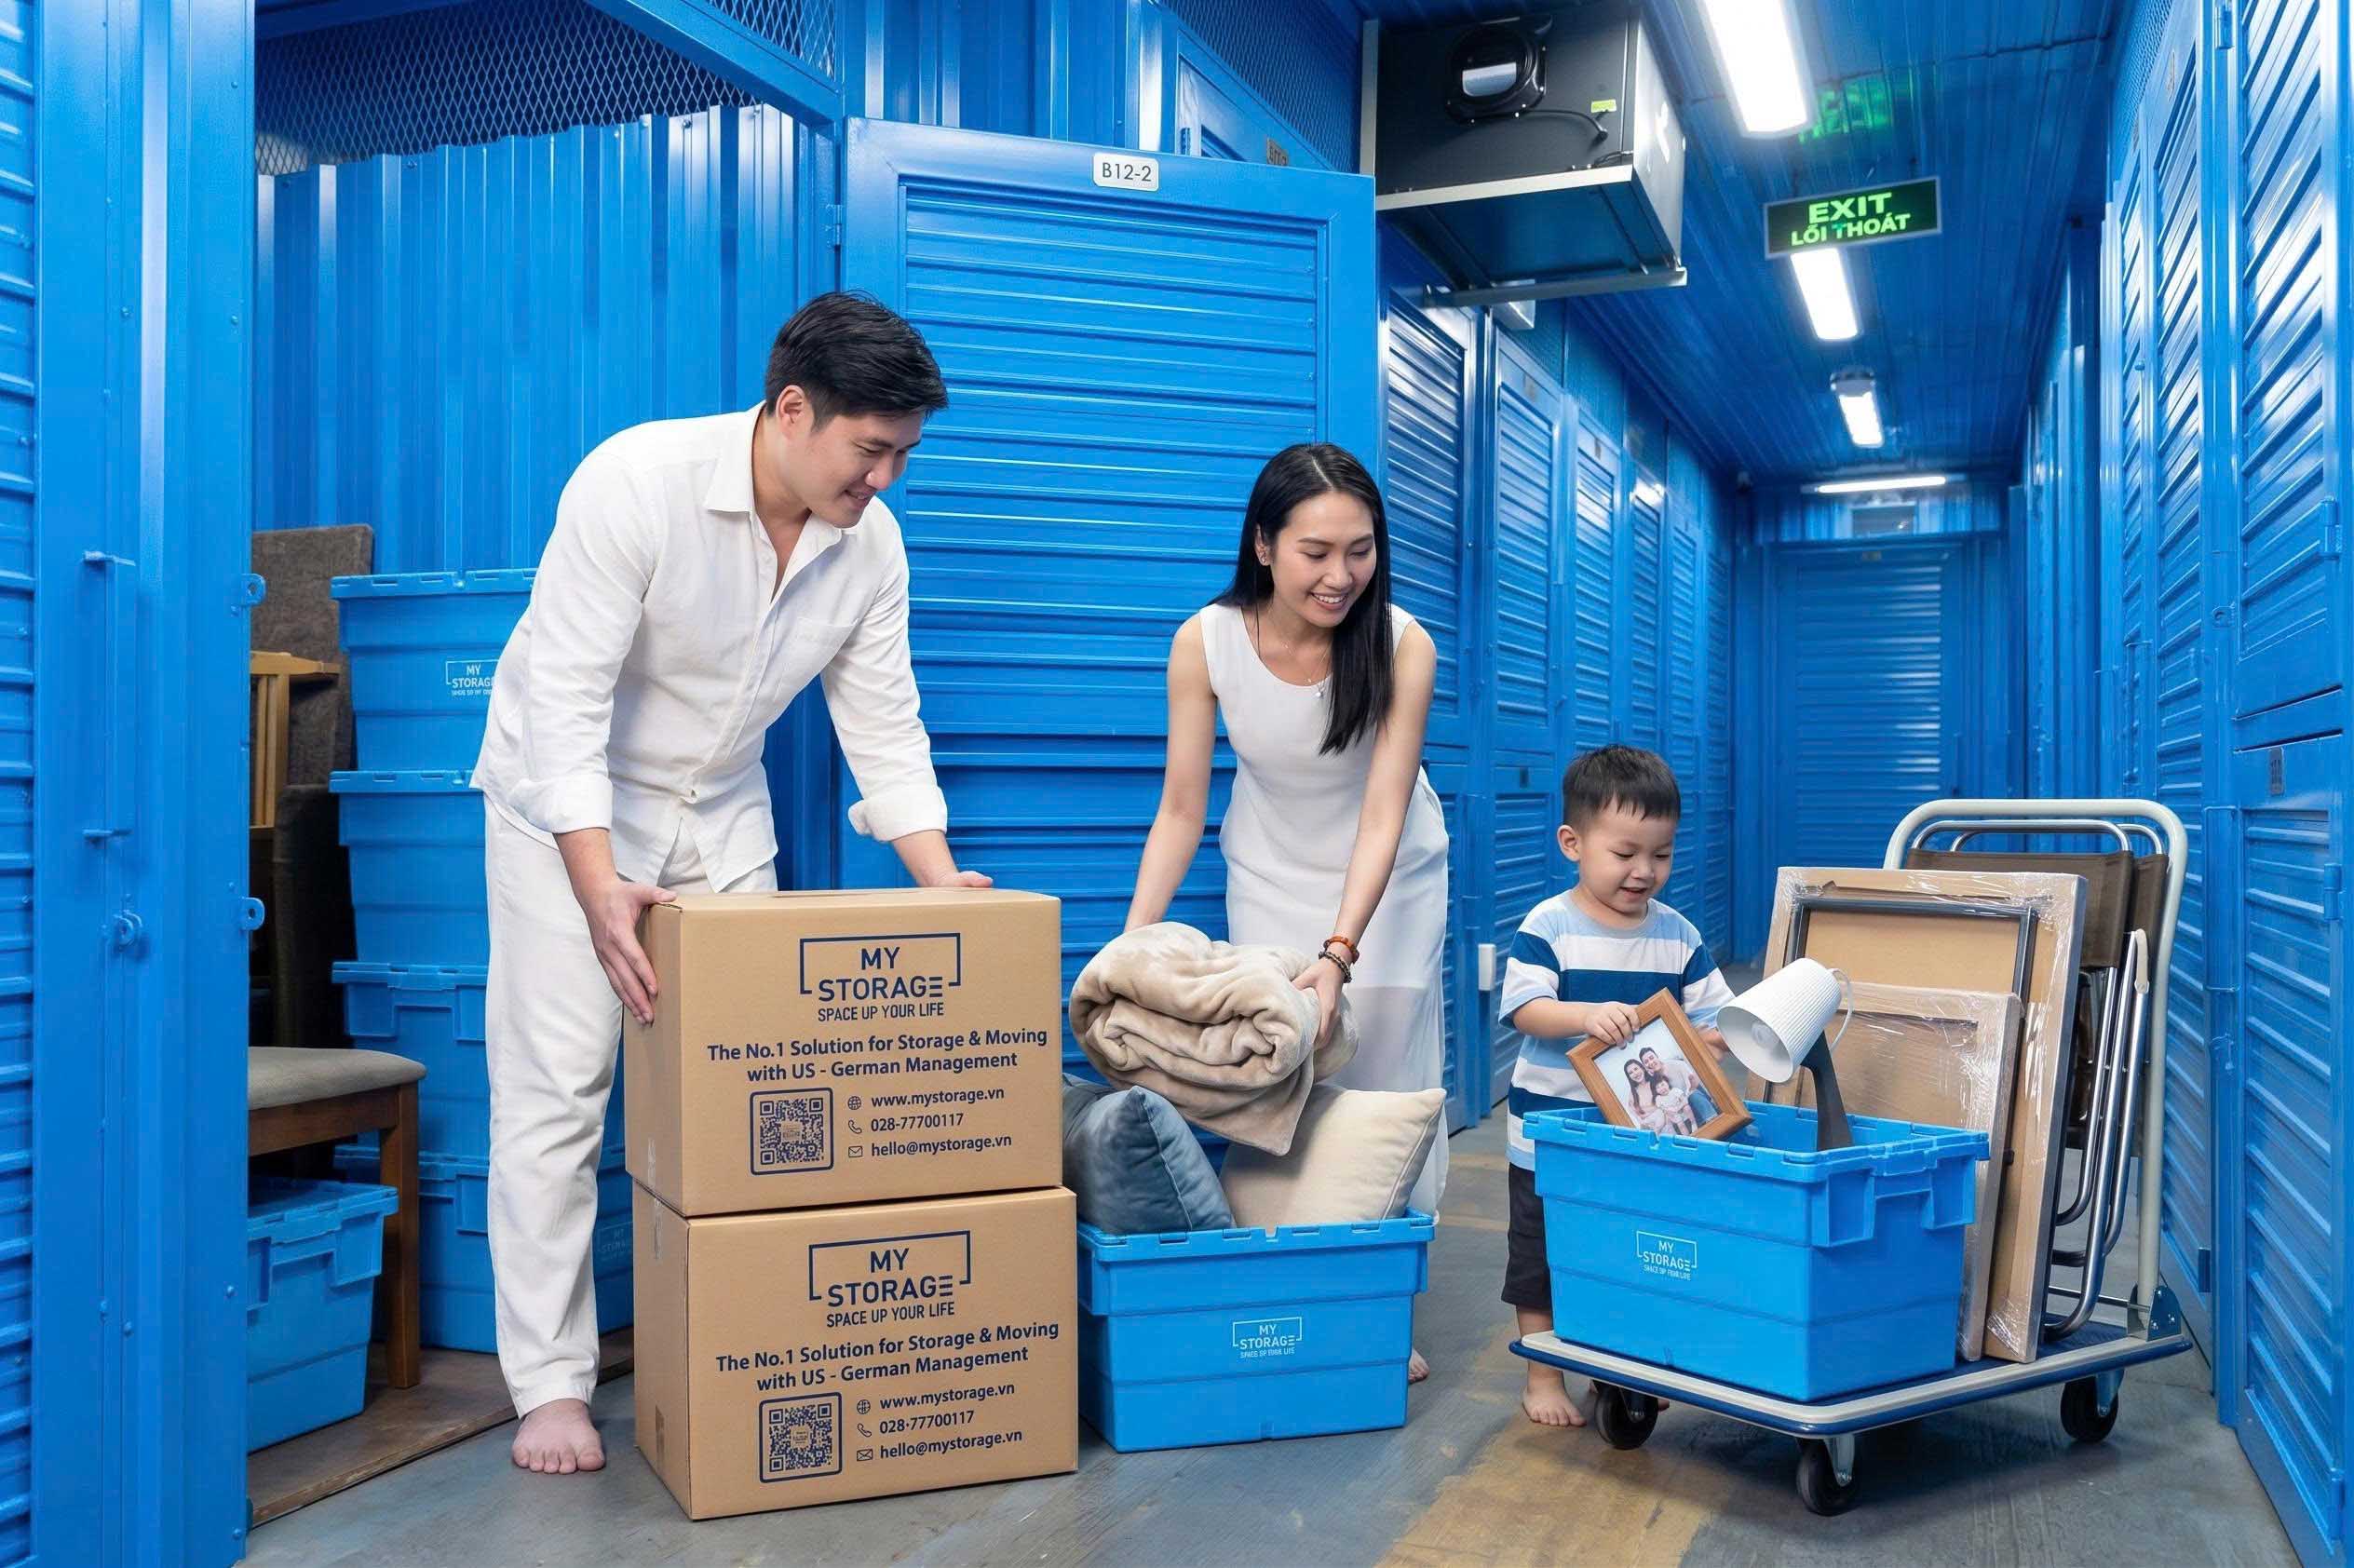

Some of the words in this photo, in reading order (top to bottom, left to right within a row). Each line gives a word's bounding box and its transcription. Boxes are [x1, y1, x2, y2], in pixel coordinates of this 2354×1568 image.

[1102, 162, 1152, 182] B12-2
[1808, 192, 1892, 224] EXIT
[1832, 212, 1911, 239] THOÁT
[466, 663, 481, 676] MY
[860, 946, 900, 971] MY
[818, 975, 943, 1002] STORAGE
[818, 1006, 859, 1022] SPACE
[861, 1006, 878, 1021] UP
[881, 1004, 915, 1019] YOUR
[919, 1002, 944, 1017] LIFE
[707, 1044, 741, 1061] The
[746, 1042, 783, 1059] No.1
[790, 1037, 864, 1057] Solution
[867, 1034, 894, 1052] for
[899, 1034, 965, 1053] Storage
[968, 1030, 981, 1047] &
[985, 1028, 1048, 1047] Moving
[747, 1063, 787, 1082] with
[791, 1062, 816, 1079] US
[831, 1061, 900, 1077] German
[905, 1052, 1018, 1076] Management
[872, 1088, 1005, 1108] www.mystorage.vn
[871, 1112, 964, 1132] 028-77700117
[872, 1135, 1012, 1157] hello@mystorage.vn
[1658, 1240, 1674, 1253] MY
[870, 1247, 910, 1274] MY
[1643, 1250, 1691, 1272] STORAGE
[828, 1275, 954, 1306] STORAGE
[826, 1310, 868, 1329] SPACE
[871, 1308, 888, 1324] UP
[891, 1304, 925, 1321] YOUR
[928, 1301, 955, 1318] LIFE
[1239, 1334, 1295, 1350] STORAGE
[1259, 1323, 1277, 1336] MY
[715, 1355, 751, 1372] The
[754, 1348, 793, 1369] No.1
[800, 1344, 874, 1363] Solution
[878, 1337, 904, 1355] for
[909, 1332, 975, 1354] Storage
[979, 1327, 993, 1344] &
[995, 1321, 1059, 1342] Moving
[756, 1372, 796, 1391] with
[802, 1368, 826, 1386] US
[840, 1362, 911, 1382] German
[915, 1346, 1029, 1375] Management
[879, 1384, 1015, 1410] www.mystorage.vn
[880, 1430, 1022, 1459] hello@mystorage.vn
